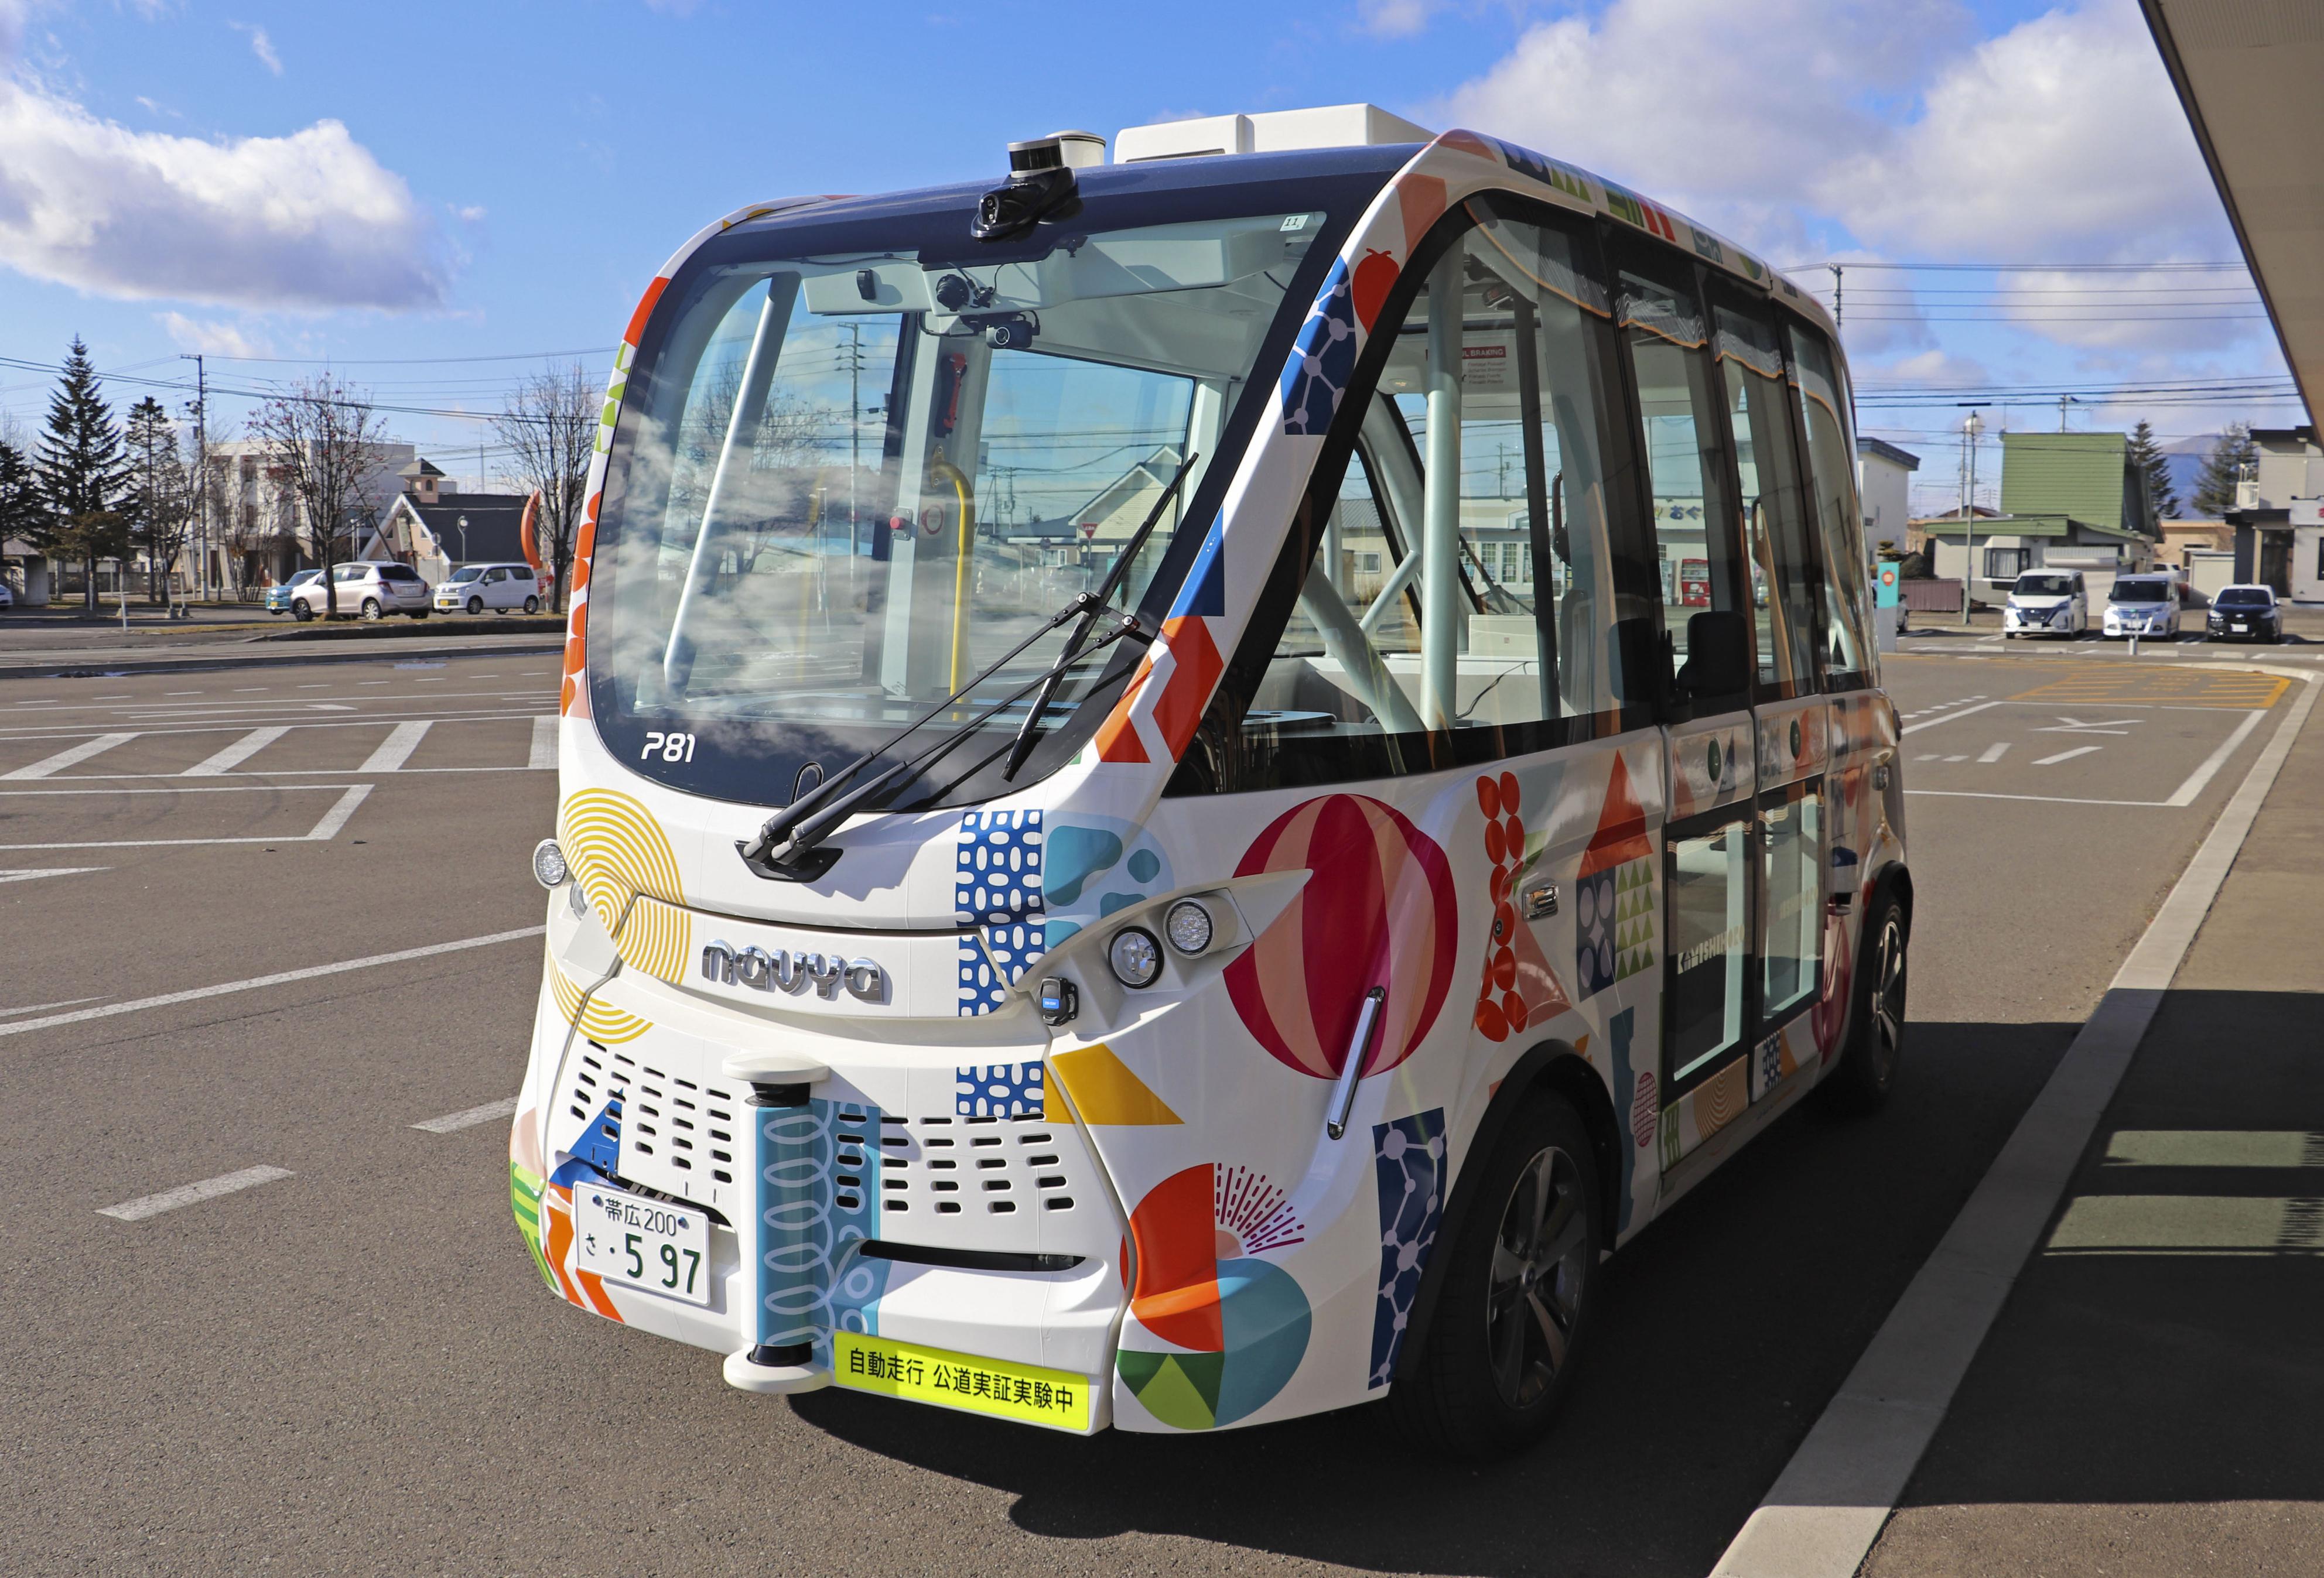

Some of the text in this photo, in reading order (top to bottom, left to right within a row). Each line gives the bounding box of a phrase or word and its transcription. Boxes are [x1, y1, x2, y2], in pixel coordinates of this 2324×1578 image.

[1470, 348, 1504, 357] BRAKING
[641, 732, 696, 762] P81
[702, 939, 884, 1002] navya
[586, 1233, 596, 1257] さ
[850, 1347, 1072, 1413] 自動走行 公道実証実験中
